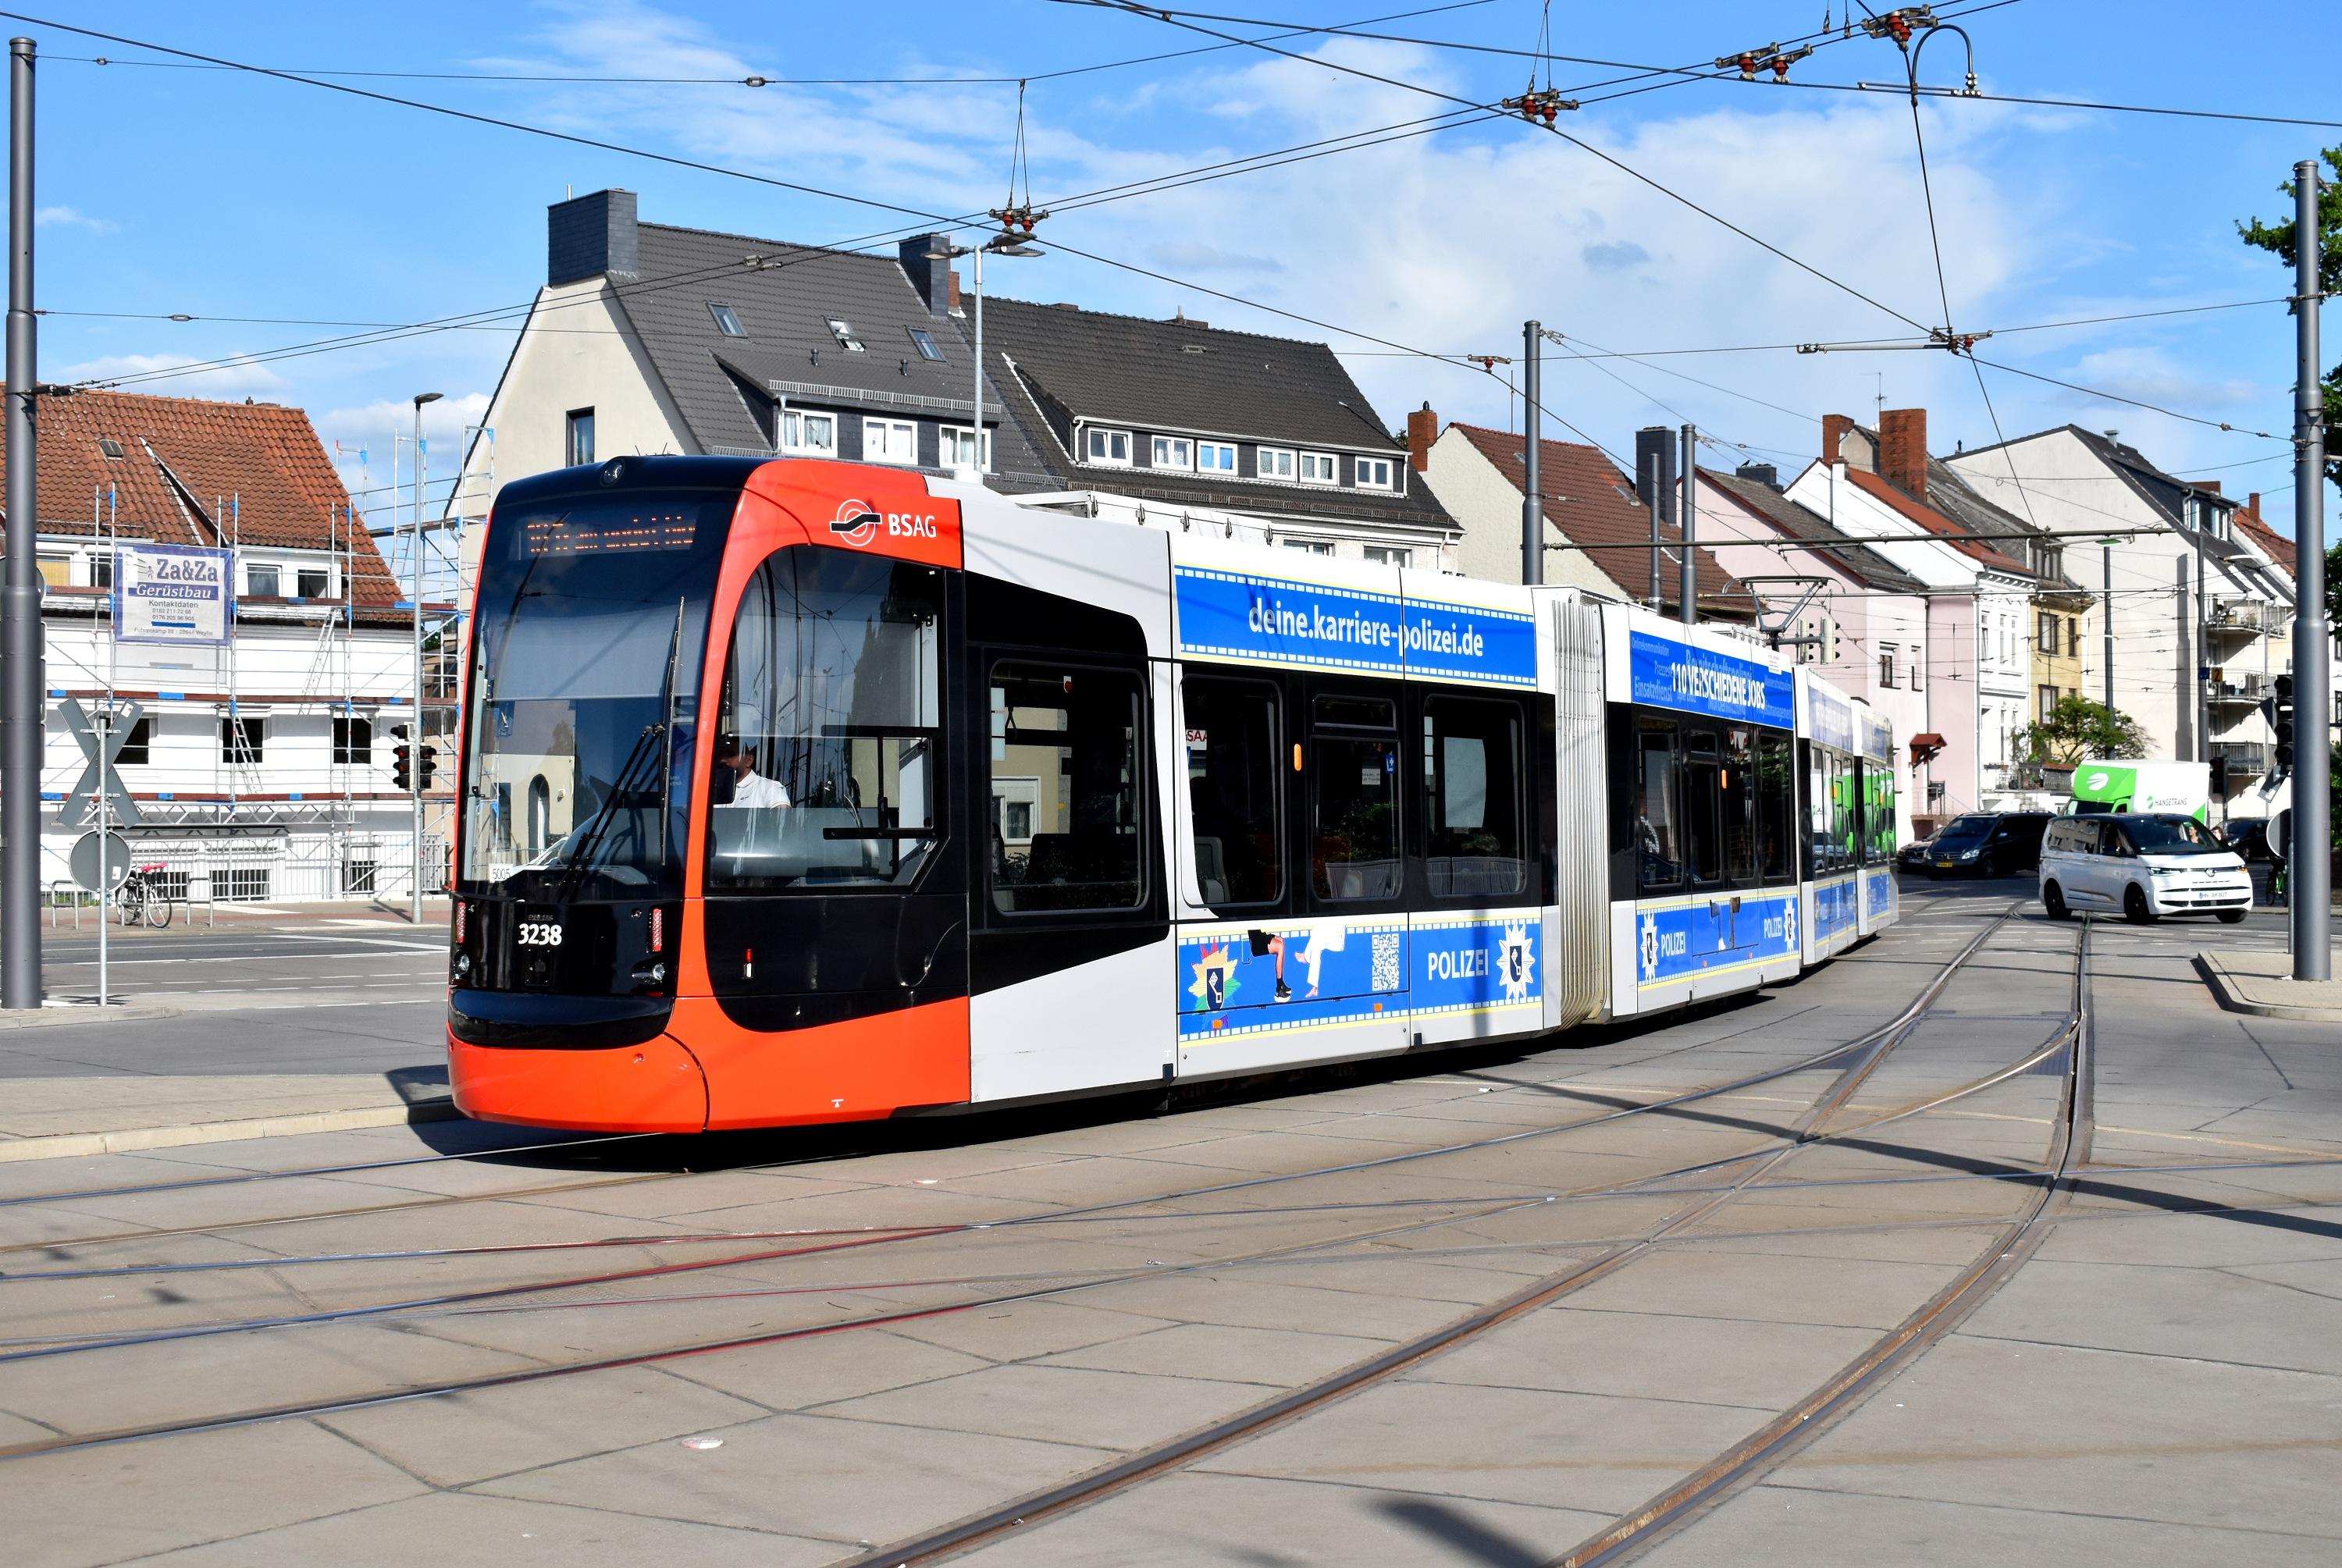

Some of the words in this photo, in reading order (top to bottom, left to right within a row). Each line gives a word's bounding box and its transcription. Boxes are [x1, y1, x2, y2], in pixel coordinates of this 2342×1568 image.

[888, 514, 936, 538] BSAG
[157, 559, 218, 582] Za&Za
[137, 584, 211, 599] Gerüstbau
[148, 599, 198, 608] Kontaktdaten
[1249, 597, 1483, 656] deine.karriere-polizei.de
[1635, 675, 1673, 702] Einsatzdienst
[1671, 662, 1686, 695] 110
[1687, 664, 1747, 706] VERSCHIEDENE
[1747, 679, 1766, 710] JOBS
[493, 869, 511, 880] 5005
[518, 923, 562, 946] 3238
[1764, 916, 1781, 939] POLIZEI
[1661, 931, 1686, 958] POLIZEI
[1428, 948, 1489, 981] POLIZEI
